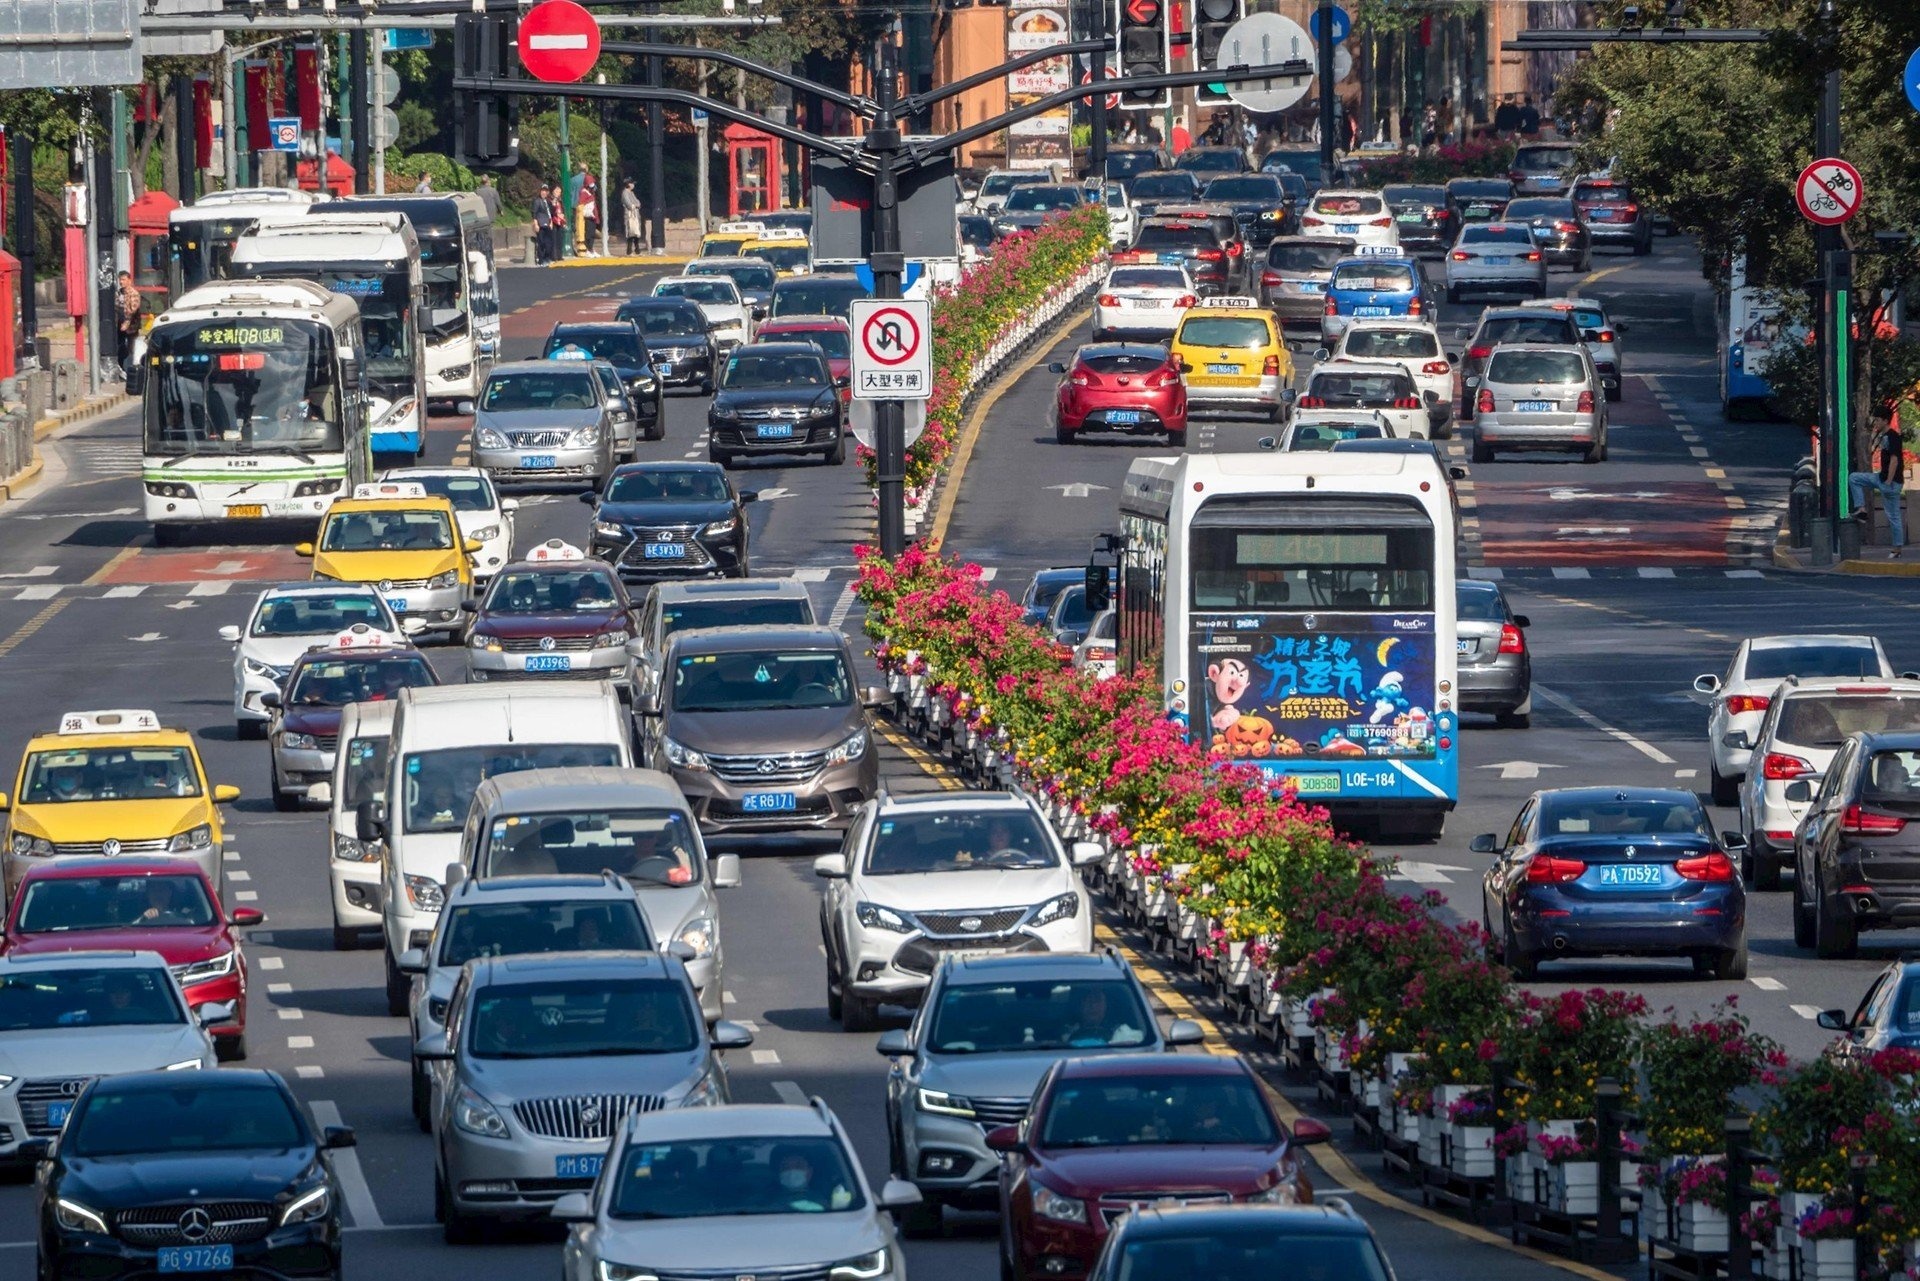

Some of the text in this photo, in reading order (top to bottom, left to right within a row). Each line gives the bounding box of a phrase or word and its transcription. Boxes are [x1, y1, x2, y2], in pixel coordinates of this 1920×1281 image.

[866, 374, 919, 388] 大型号牌
[1272, 636, 1352, 660] 精灵之城
[1261, 657, 1363, 699] 万圣节
[66, 716, 155, 731] 强 生
[1363, 728, 1409, 738] 37690888
[1302, 777, 1340, 791] 50858D
[1346, 773, 1395, 787] LOE-184
[161, 1248, 231, 1268] 沪G 97266
